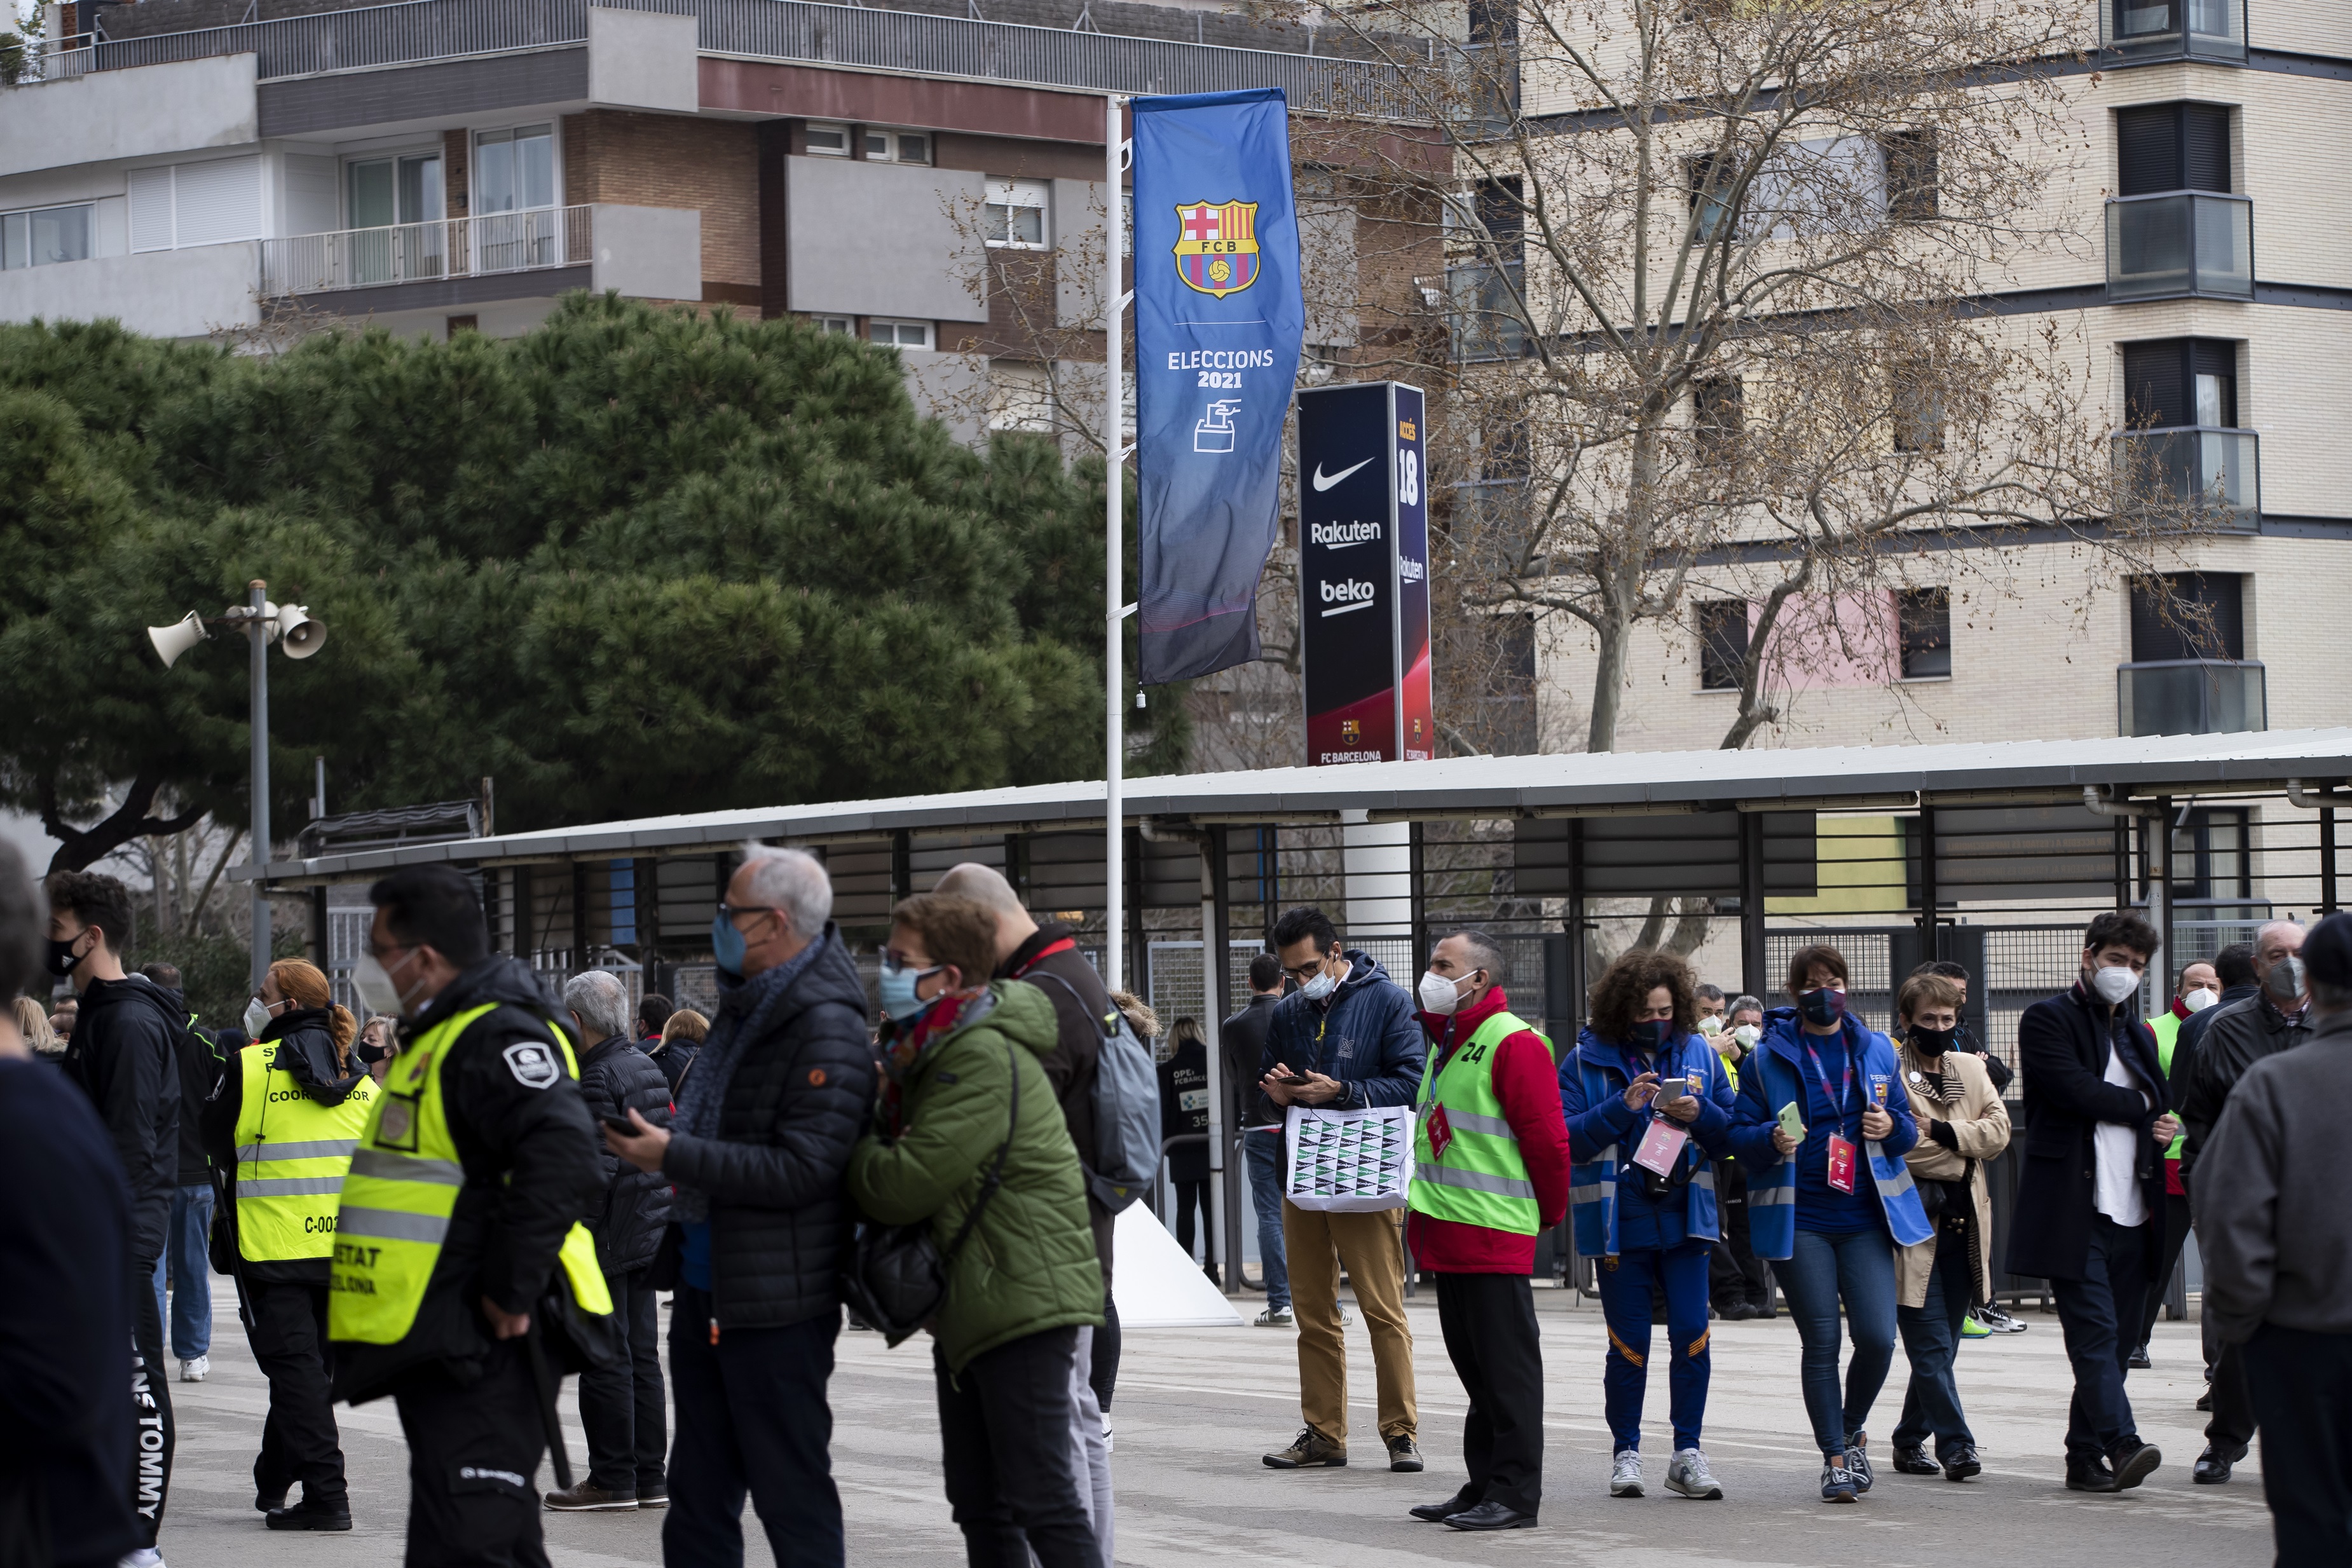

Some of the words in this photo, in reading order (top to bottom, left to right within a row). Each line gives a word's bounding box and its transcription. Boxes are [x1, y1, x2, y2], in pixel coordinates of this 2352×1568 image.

[1168, 349, 1273, 370] ELECCIONS
[1198, 371, 1242, 389] 2021
[1399, 418, 1416, 441] ACCÉS
[1399, 449, 1418, 506] 18
[1311, 520, 1381, 543] Rakuten
[1400, 555, 1423, 580] Rakuten
[1321, 578, 1374, 602] beko
[1321, 753, 1331, 763] FC
[1332, 751, 1381, 762] BARCELONA
[1460, 1042, 1487, 1065] 24
[1173, 1069, 1194, 1079] OPE
[137, 1413, 163, 1519] TOMMY
